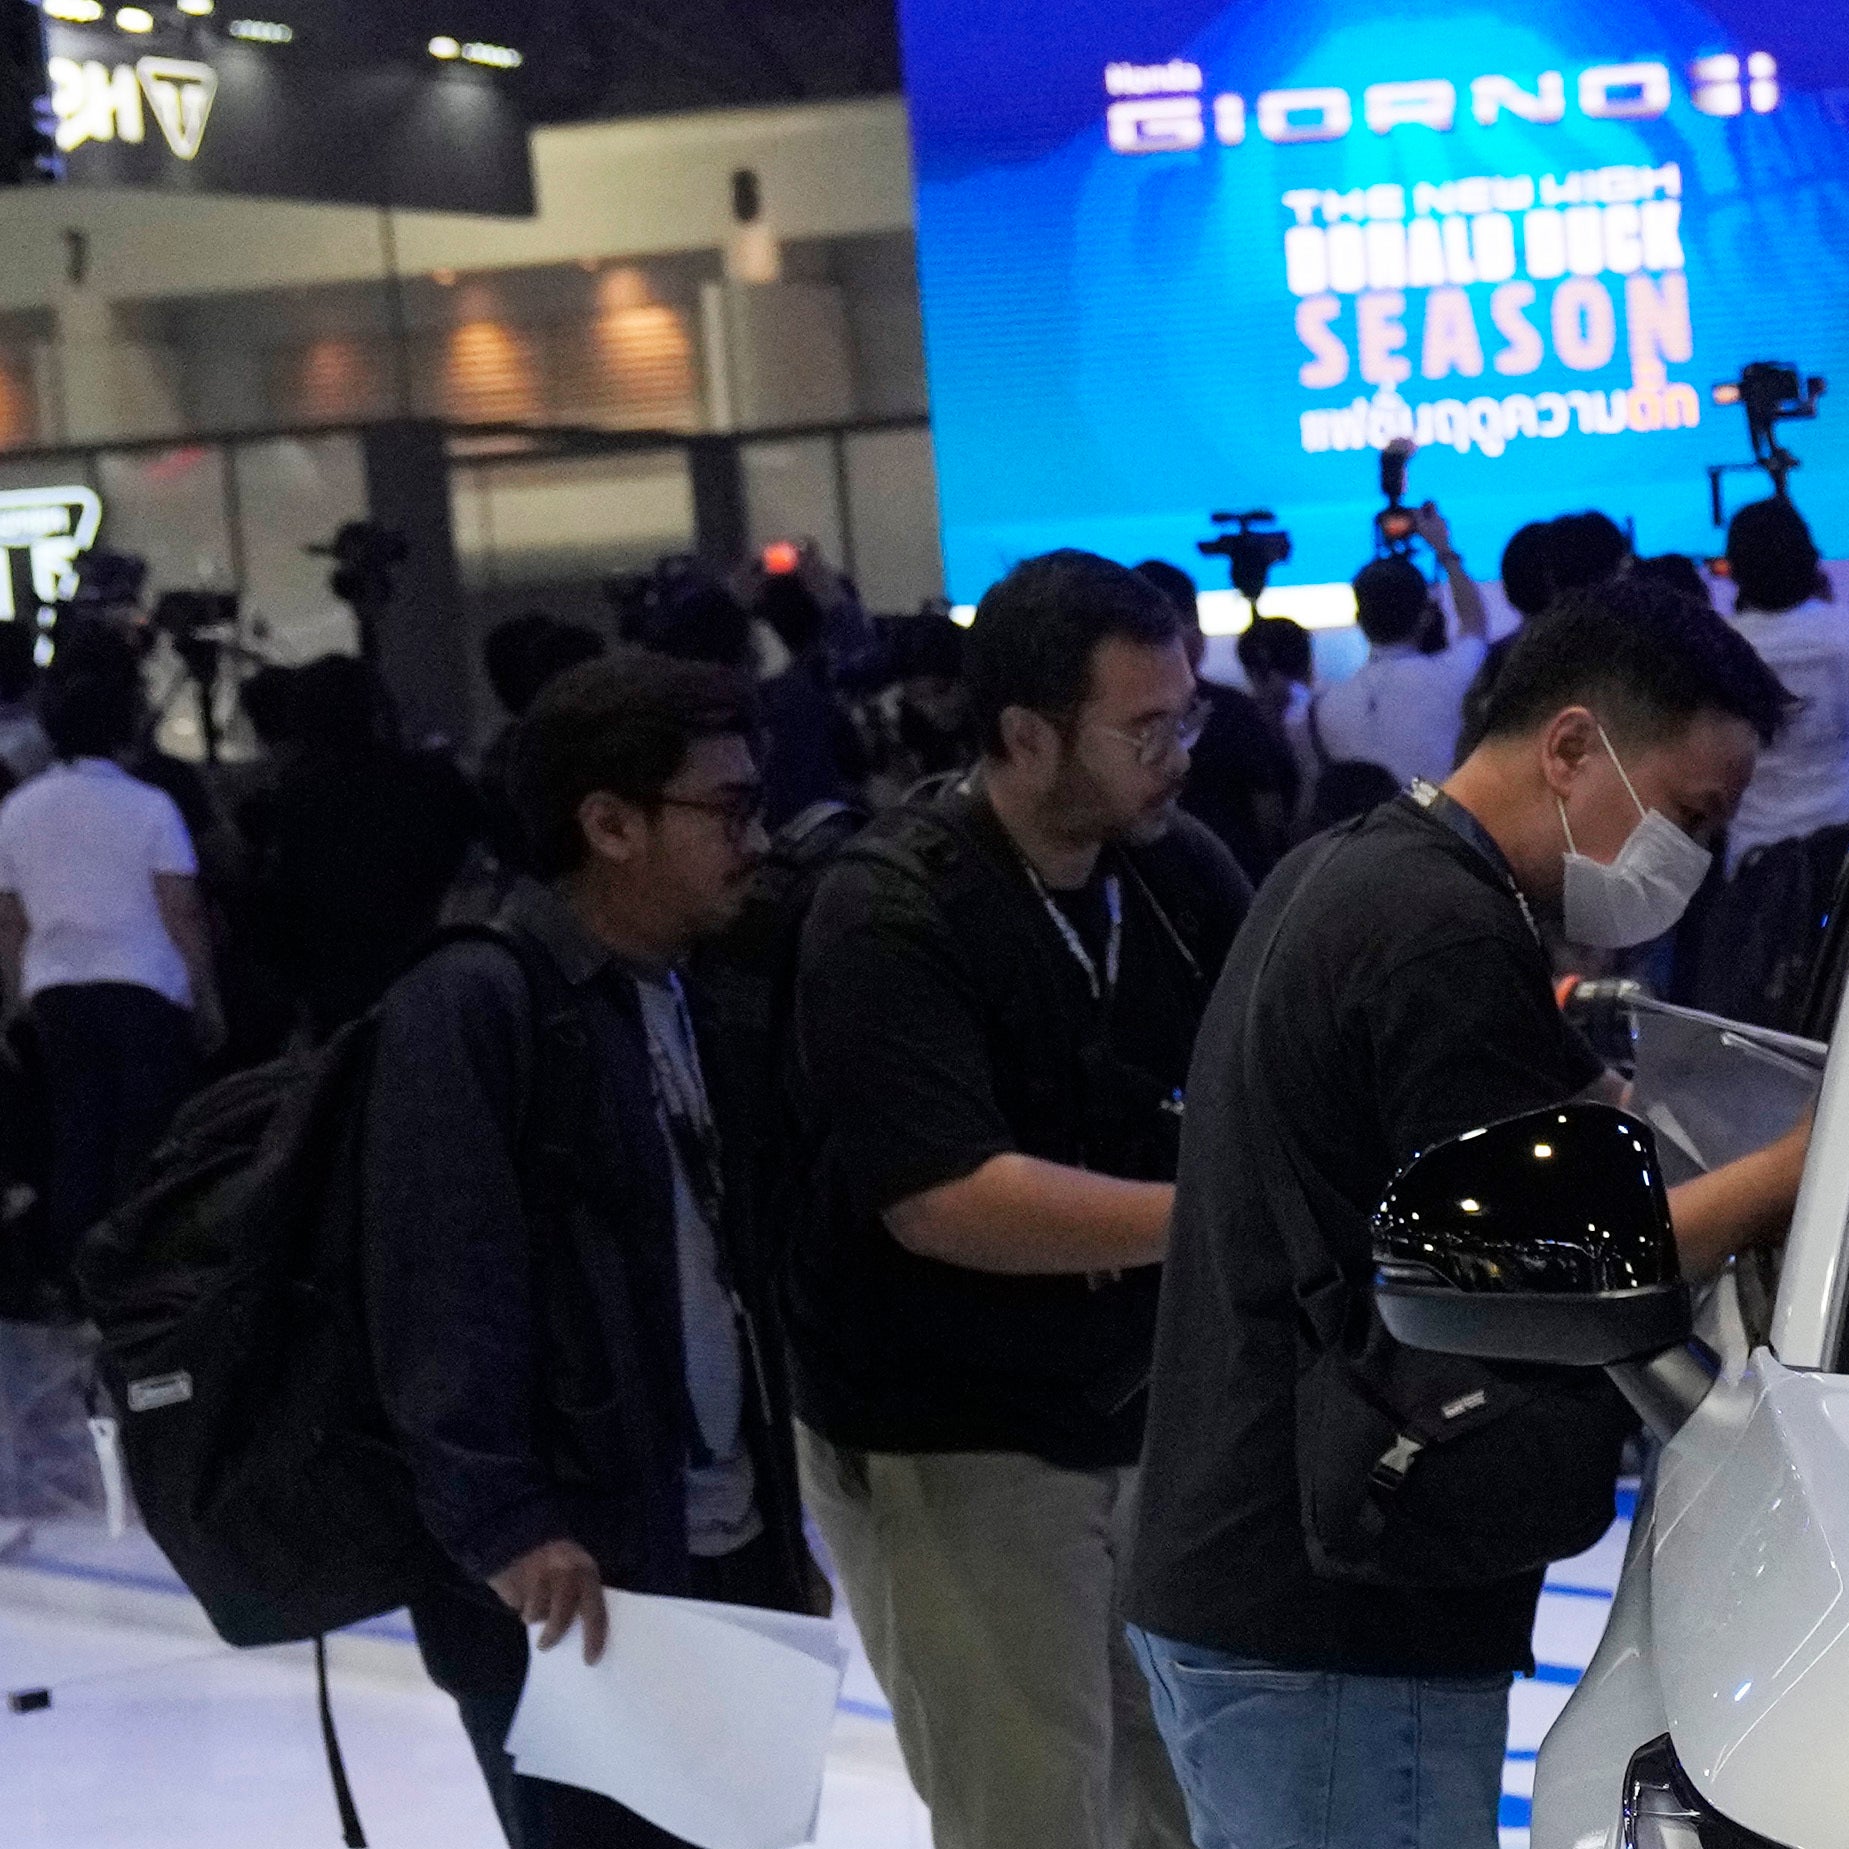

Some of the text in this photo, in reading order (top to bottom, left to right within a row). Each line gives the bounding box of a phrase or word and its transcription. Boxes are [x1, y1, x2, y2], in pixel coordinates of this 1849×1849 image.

[1282, 183, 1404, 225] THE
[1413, 174, 1535, 216] NEW
[1284, 199, 1685, 297] DONALD DUCK
[1295, 268, 1692, 389] SEASON
